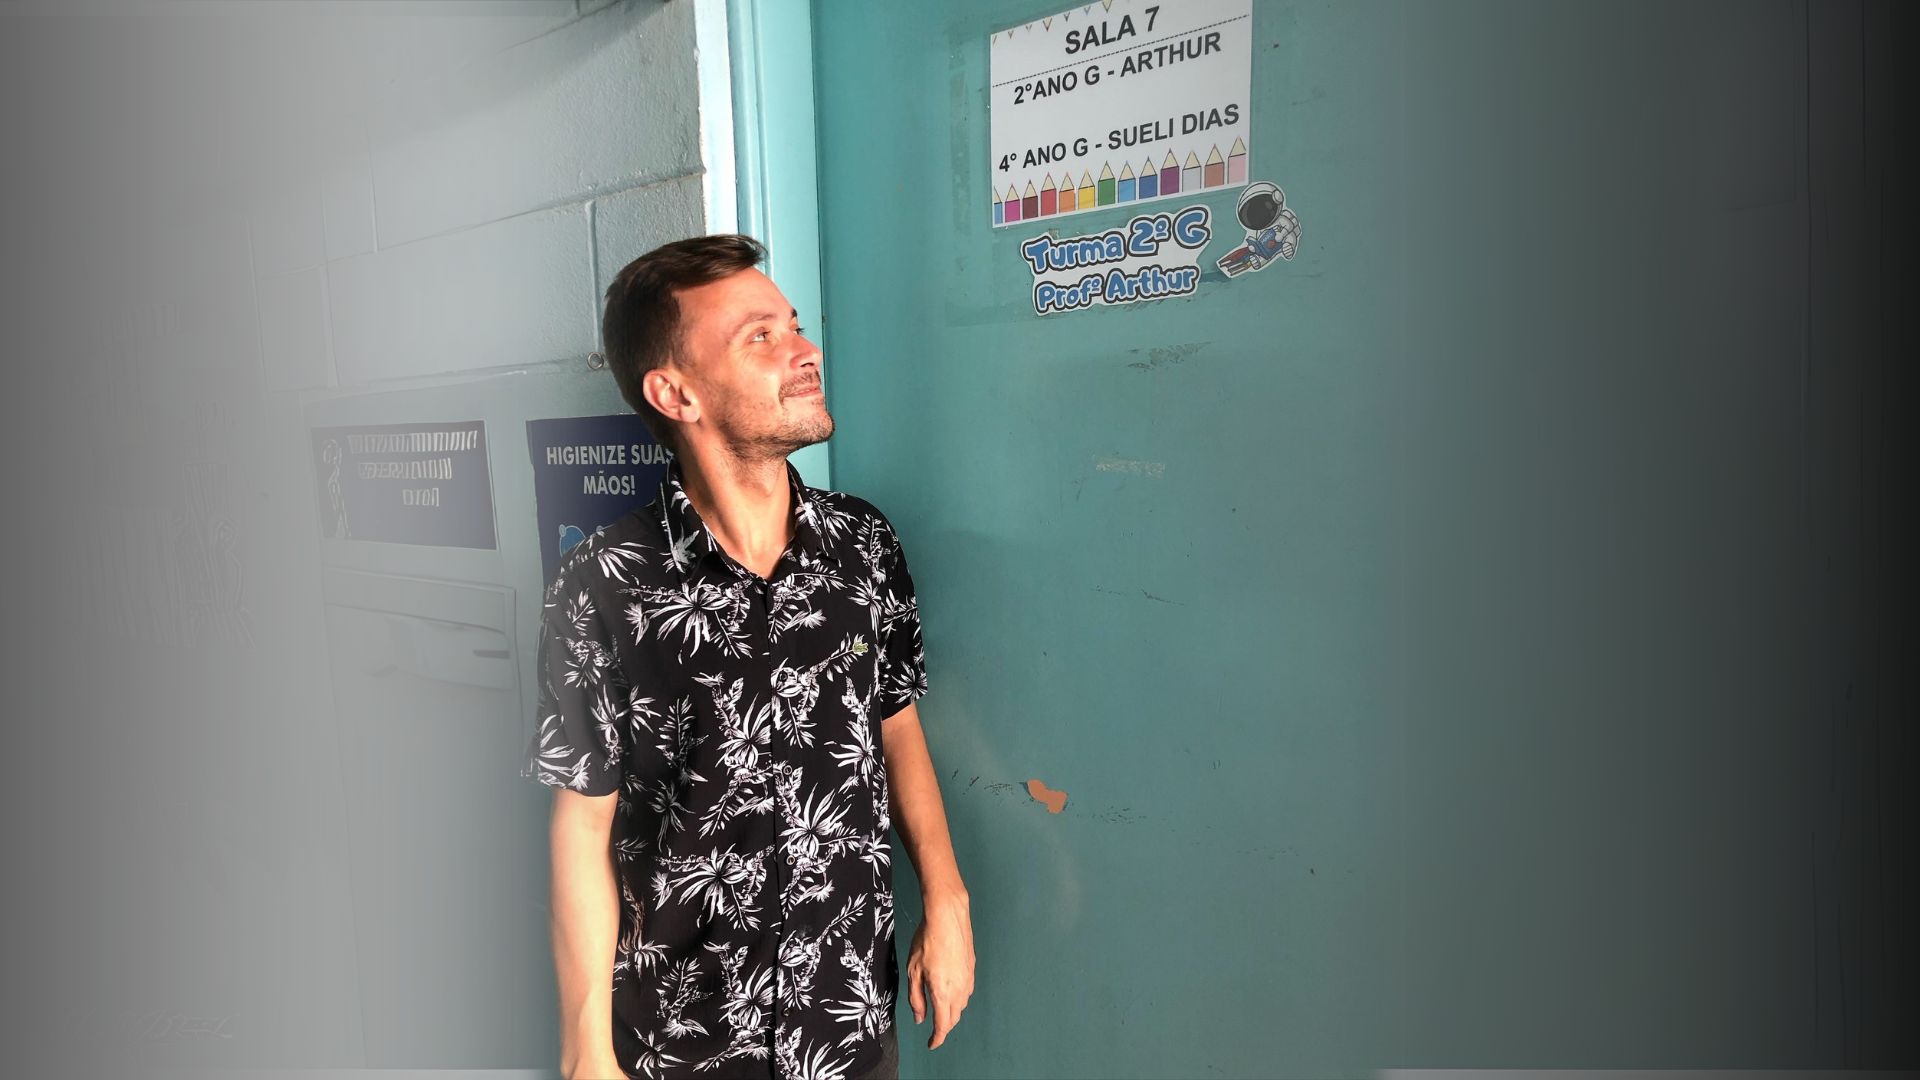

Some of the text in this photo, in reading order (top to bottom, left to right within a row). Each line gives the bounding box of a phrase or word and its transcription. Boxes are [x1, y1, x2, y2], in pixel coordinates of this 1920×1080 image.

[1065, 6, 1160, 54] SALA 7
[1084, 65, 1100, 85] G
[1120, 31, 1221, 77] ARTHUR
[1022, 142, 1066, 169] ANO
[1073, 137, 1088, 157] G
[1108, 118, 1174, 150] SUELI
[1182, 103, 1240, 136] DIAS
[1025, 233, 1126, 273] Turma
[1174, 208, 1208, 248] G
[1104, 268, 1197, 301] Arthur
[546, 445, 627, 465] HIGIENIZE
[583, 470, 635, 496] MÃOS!
